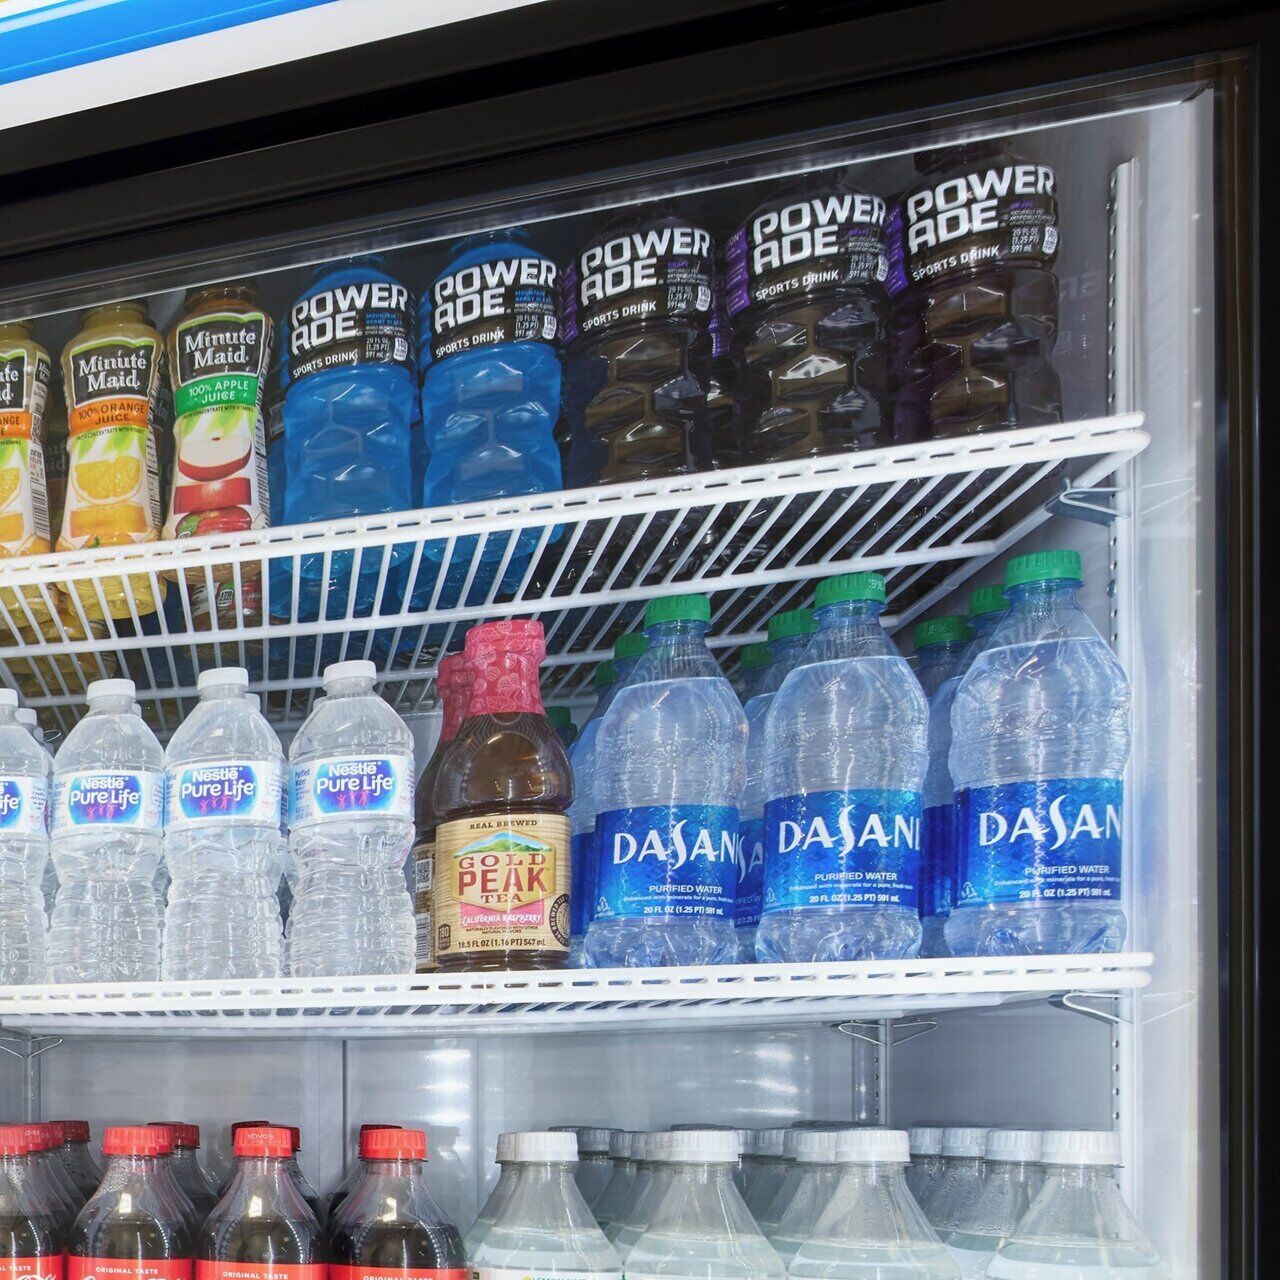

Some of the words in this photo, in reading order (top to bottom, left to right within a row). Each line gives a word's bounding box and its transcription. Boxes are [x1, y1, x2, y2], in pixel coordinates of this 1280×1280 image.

[906, 165, 1055, 223] POWER
[752, 194, 887, 246] POWER
[908, 199, 999, 255] ADE
[580, 228, 712, 277] POWER
[754, 225, 839, 276] ADE
[912, 257, 957, 281] SPORTS
[961, 245, 1000, 266] DRINK
[581, 257, 658, 307] ADE
[755, 278, 800, 301] SPORTS
[802, 270, 839, 290] DRINK
[185, 329, 256, 353] Minute
[79, 355, 147, 377] Minute
[194, 347, 248, 369] Maid
[188, 384, 212, 397] 100%
[215, 380, 248, 391] APPLE
[202, 390, 235, 402] JUICE
[79, 407, 101, 420] 100%
[102, 402, 145, 415] ORANGE
[95, 412, 129, 425] JUICE
[192, 767, 238, 782] Nestlé
[329, 761, 377, 777] Nestlé
[181, 779, 221, 799] Pure
[224, 780, 254, 801] Life
[316, 774, 359, 794] Pure
[362, 774, 394, 797] Life
[70, 789, 107, 806] Pure
[110, 789, 139, 809] Life
[496, 820, 537, 828] BREWED
[458, 853, 546, 869] GOLD
[1076, 865, 1110, 875] WATER
[458, 867, 547, 896] PEAK
[814, 872, 863, 881] PURIFIED
[865, 872, 898, 881] WATER
[481, 893, 523, 904] TEA
[649, 885, 694, 894] PURIFIED
[695, 885, 723, 894] WATER
[643, 906, 653, 914] 20
[654, 906, 663, 914] FL
[675, 907, 692, 915] (1.25
[96, 1267, 133, 1275] ORIGINAL
[223, 1271, 261, 1279] ORIGINAL
[263, 1272, 288, 1280] TASTE
